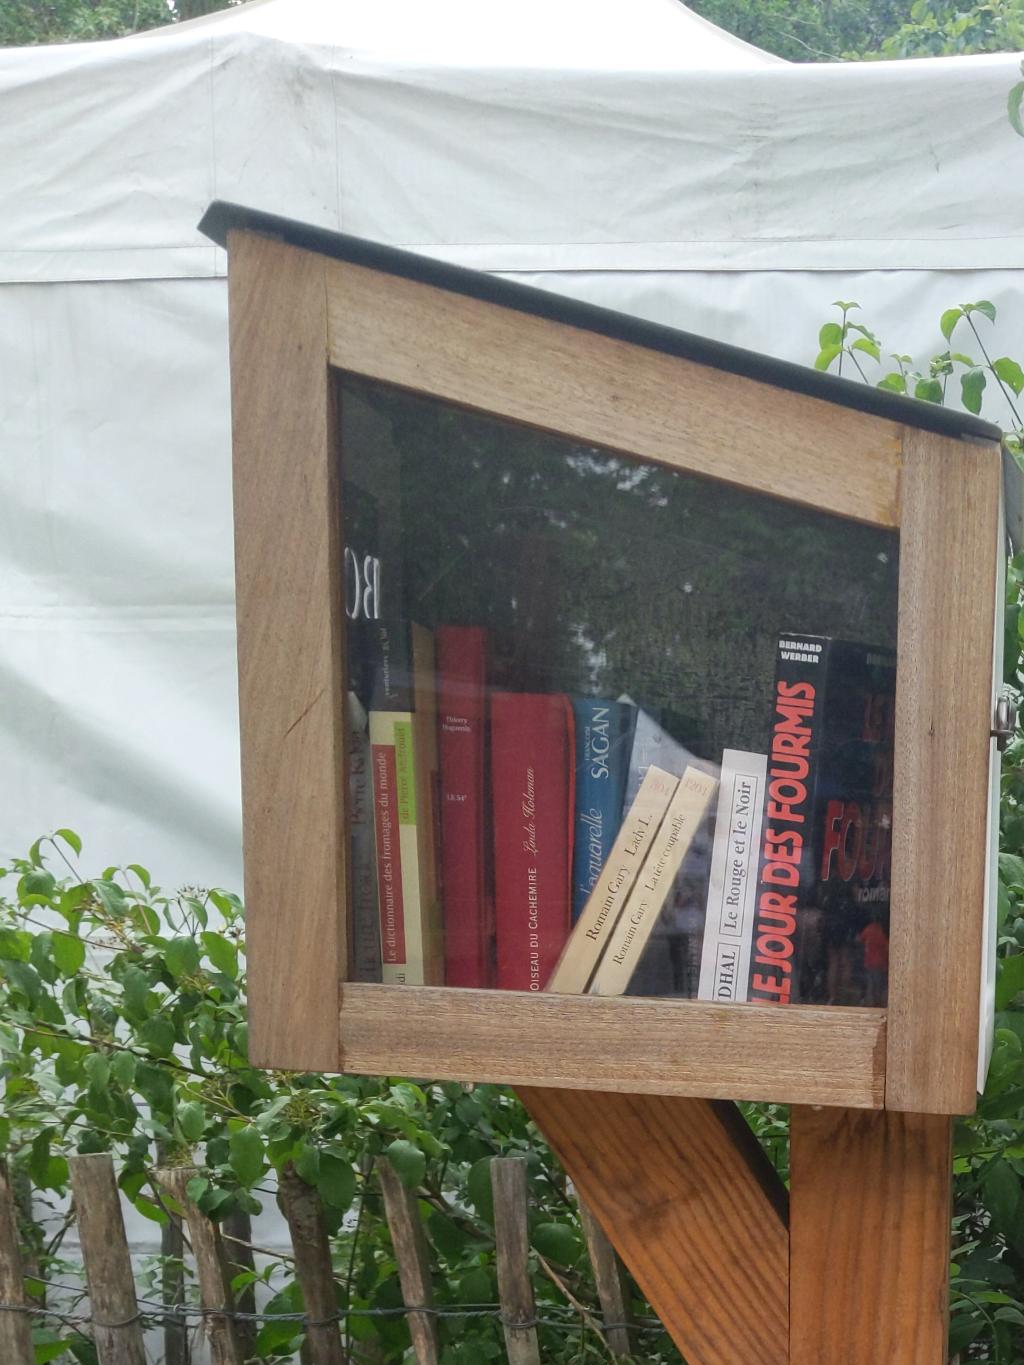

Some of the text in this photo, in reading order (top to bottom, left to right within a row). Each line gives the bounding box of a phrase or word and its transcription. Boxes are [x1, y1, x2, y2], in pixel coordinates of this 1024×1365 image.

[778, 640, 823, 653] BERNARD
[780, 651, 819, 663] WERBER
[590, 706, 610, 779] SAGAN
[766, 680, 816, 823] FOURMIS
[735, 781, 752, 816] Noir
[521, 821, 541, 857] Linda
[732, 820, 748, 836] le
[733, 840, 746, 855] et
[375, 752, 397, 963] Le dictionnaire des fromages du monde
[584, 893, 619, 941] Romain
[605, 863, 633, 895] Gary
[623, 824, 650, 857] Lady
[726, 858, 747, 907] Rouge
[761, 828, 803, 888] DES
[610, 925, 638, 967] Romain
[626, 900, 649, 926] Gary
[643, 876, 657, 892] La
[659, 813, 687, 858] coupable
[526, 866, 541, 990] OISEAU DU CACHEMIRE
[723, 911, 738, 929] Le
[754, 891, 797, 974] JOUR
